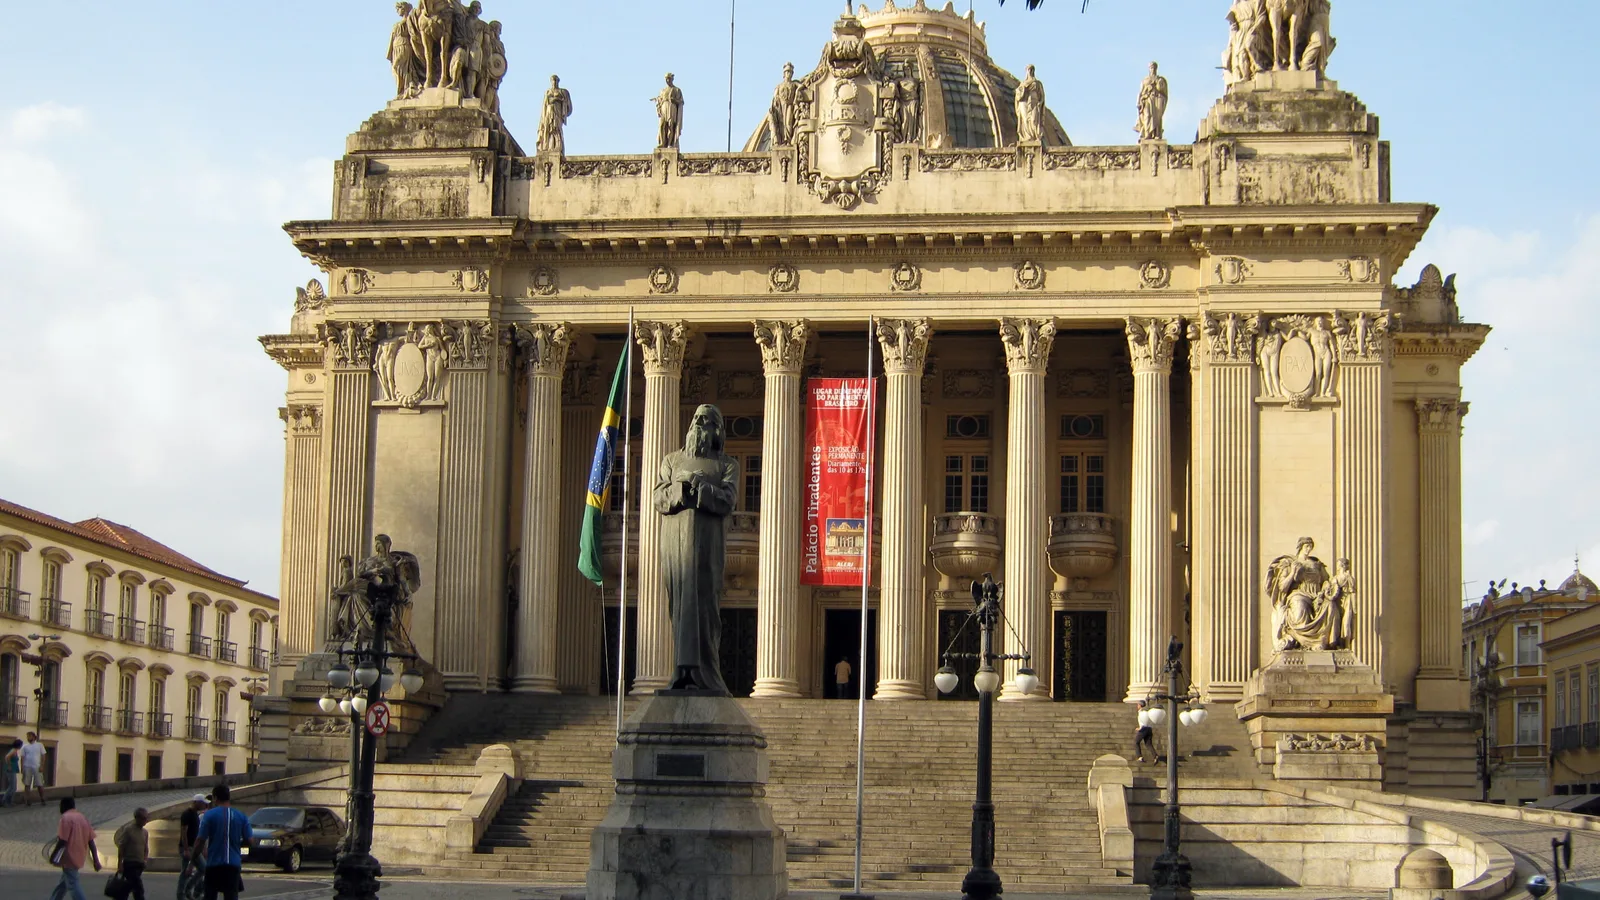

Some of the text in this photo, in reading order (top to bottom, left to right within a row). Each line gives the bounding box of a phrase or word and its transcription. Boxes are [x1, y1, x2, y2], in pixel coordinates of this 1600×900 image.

[1285, 355, 1309, 373] PAX
[806, 446, 821, 573] Palácio Tiradentes
